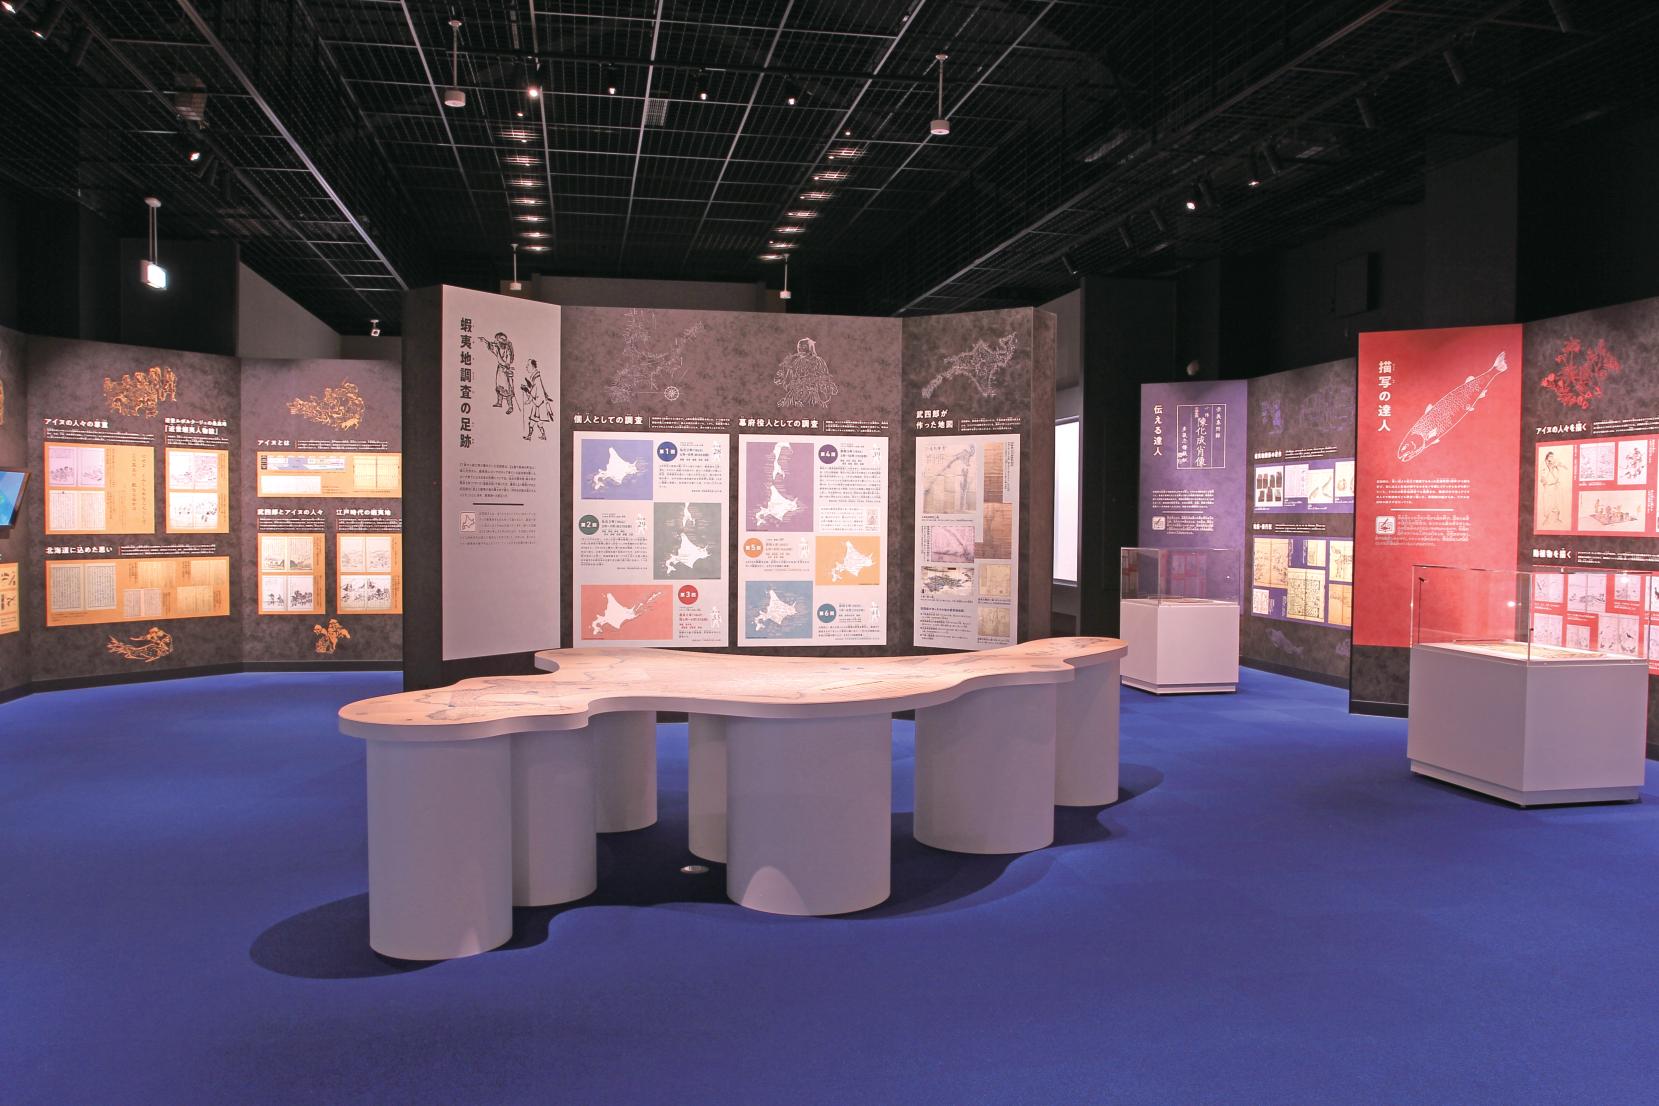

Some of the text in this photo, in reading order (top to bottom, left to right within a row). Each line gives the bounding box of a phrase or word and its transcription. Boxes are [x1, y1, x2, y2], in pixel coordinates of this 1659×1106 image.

[460, 317, 471, 448] 蝦夷地調査の足跡
[1378, 361, 1392, 432] 描写の達人
[916, 410, 948, 419] 武四郎が
[573, 415, 643, 425] 個人としての調査
[738, 418, 819, 428] 幕府役人としての調査
[916, 420, 954, 430] 作った地図
[1153, 405, 1163, 456] 伝える達人
[1536, 423, 1587, 435] アイヌの人々を描く
[257, 439, 290, 447] アイヌとは
[257, 508, 324, 516] 武四郎とアイヌの人々
[45, 546, 113, 555] 北海道に込めた思い
